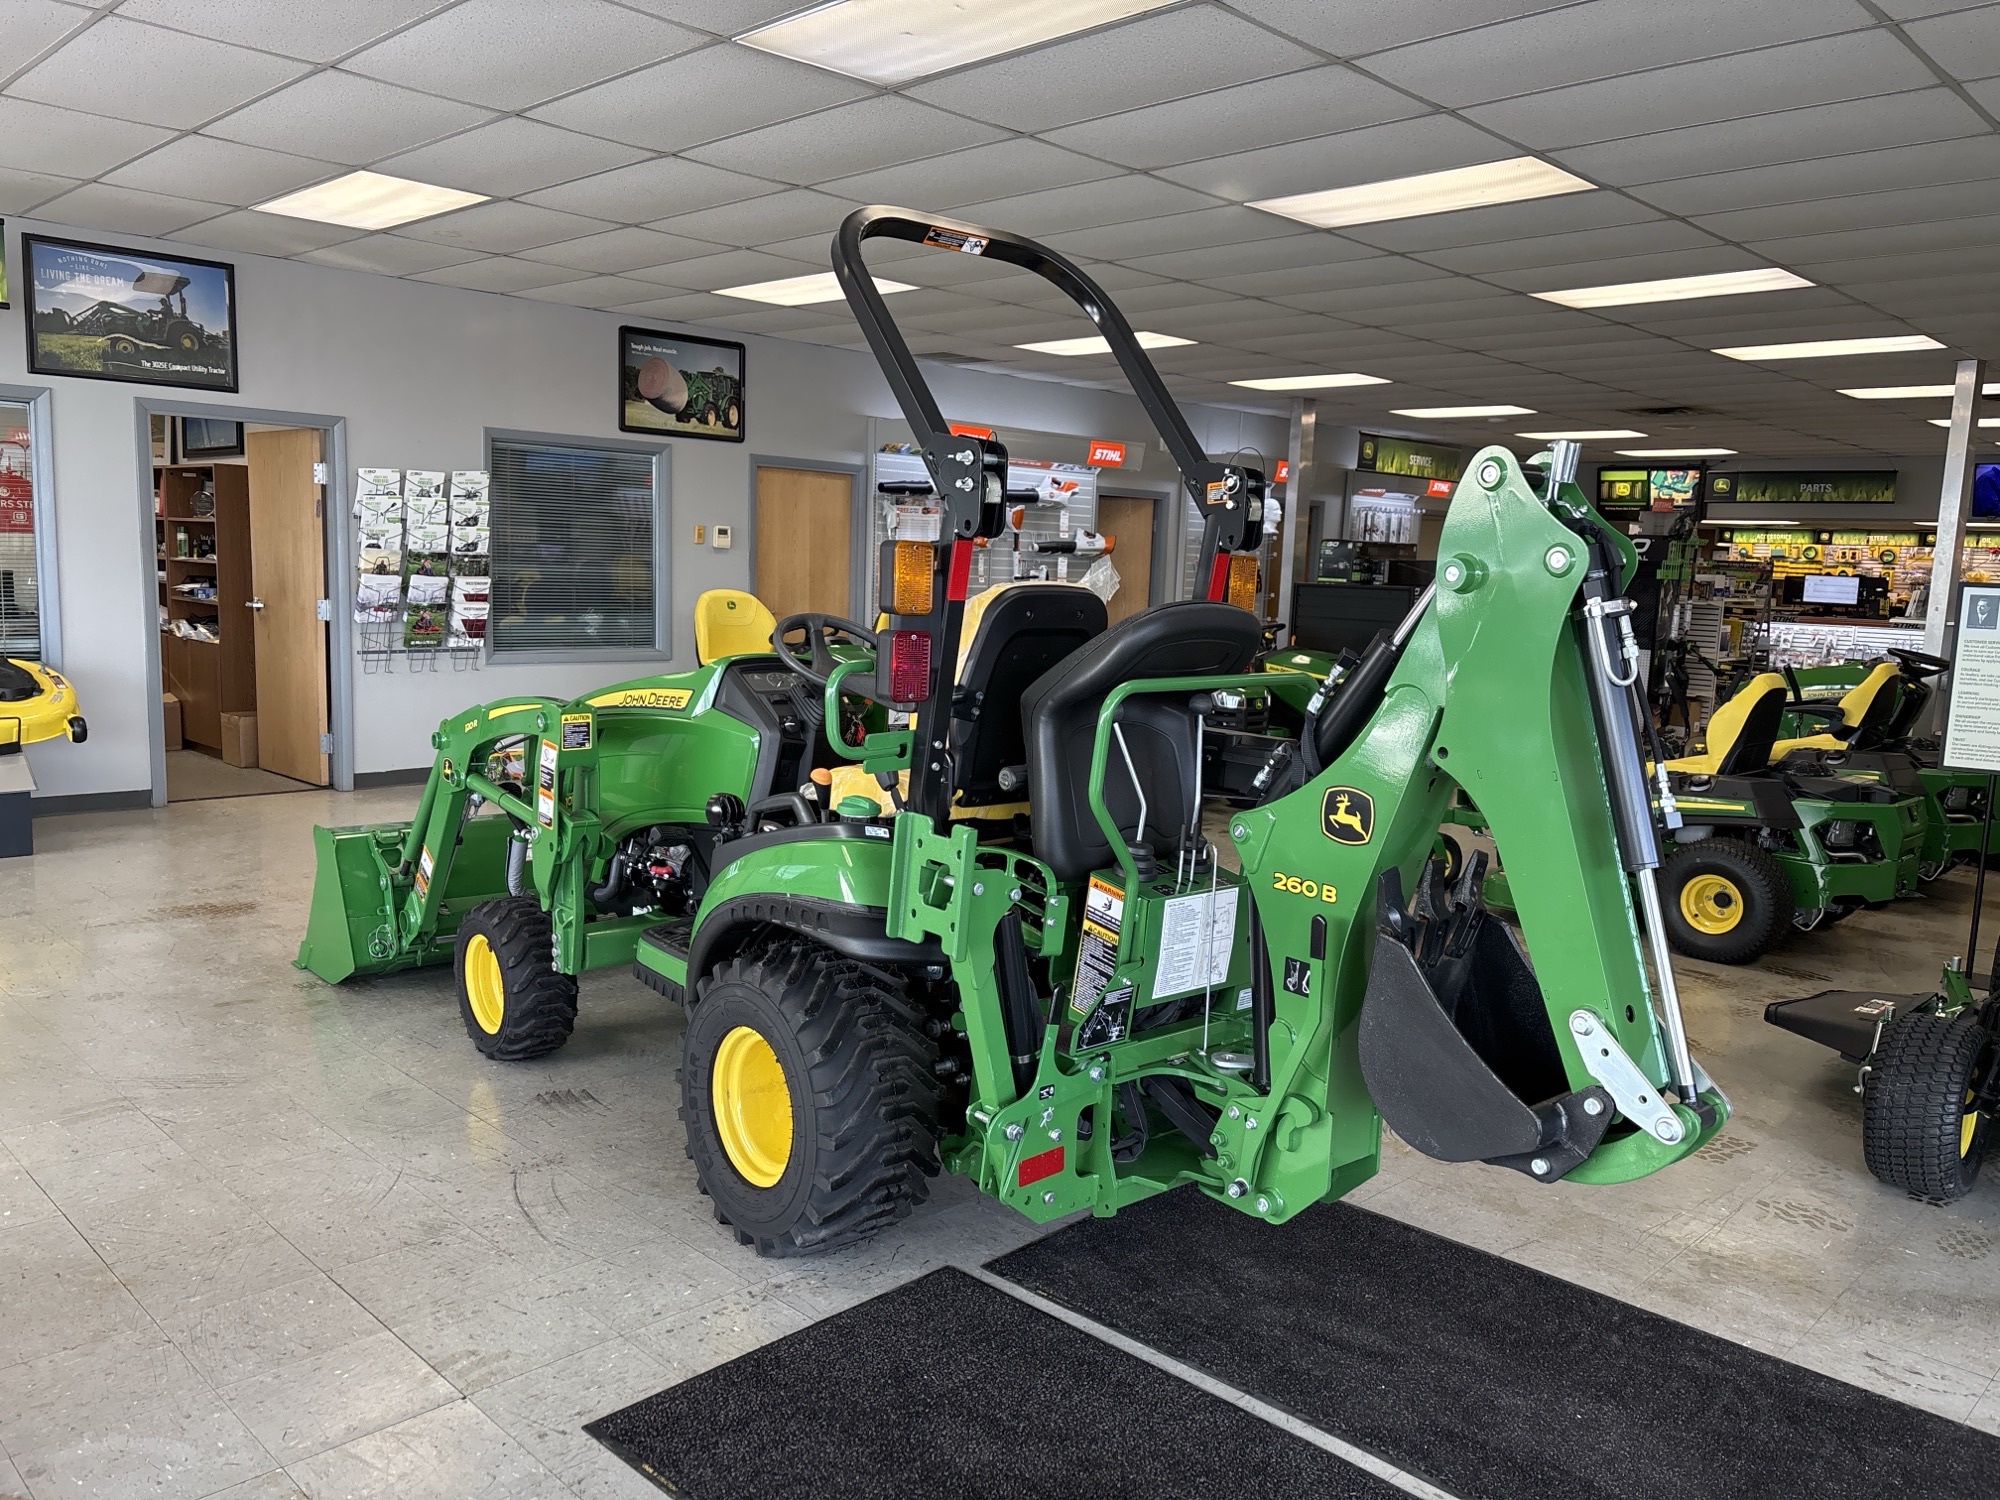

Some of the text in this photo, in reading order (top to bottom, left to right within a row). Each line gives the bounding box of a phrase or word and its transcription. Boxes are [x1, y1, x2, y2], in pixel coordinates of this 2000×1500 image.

[57, 255, 108, 270] NOTHING RUNS
[40, 267, 71, 281] LIVING
[73, 272, 92, 284] THE
[94, 275, 124, 287] DREAM
[141, 360, 151, 368] The
[168, 362, 191, 372] Compact
[191, 364, 208, 374] Utility
[208, 366, 226, 375] Tractor
[1093, 448, 1122, 462] STIHL
[1409, 454, 1432, 467] SERVICE
[1432, 482, 1450, 492] STIHL
[1800, 483, 1832, 493] PARTS
[1653, 501, 1673, 509] STIHL
[618, 692, 684, 707] JOHN DEERE
[1273, 871, 1338, 904] 260 B
[1092, 927, 1118, 944] CAUTION
[688, 1052, 714, 1172] CARLSTAR
